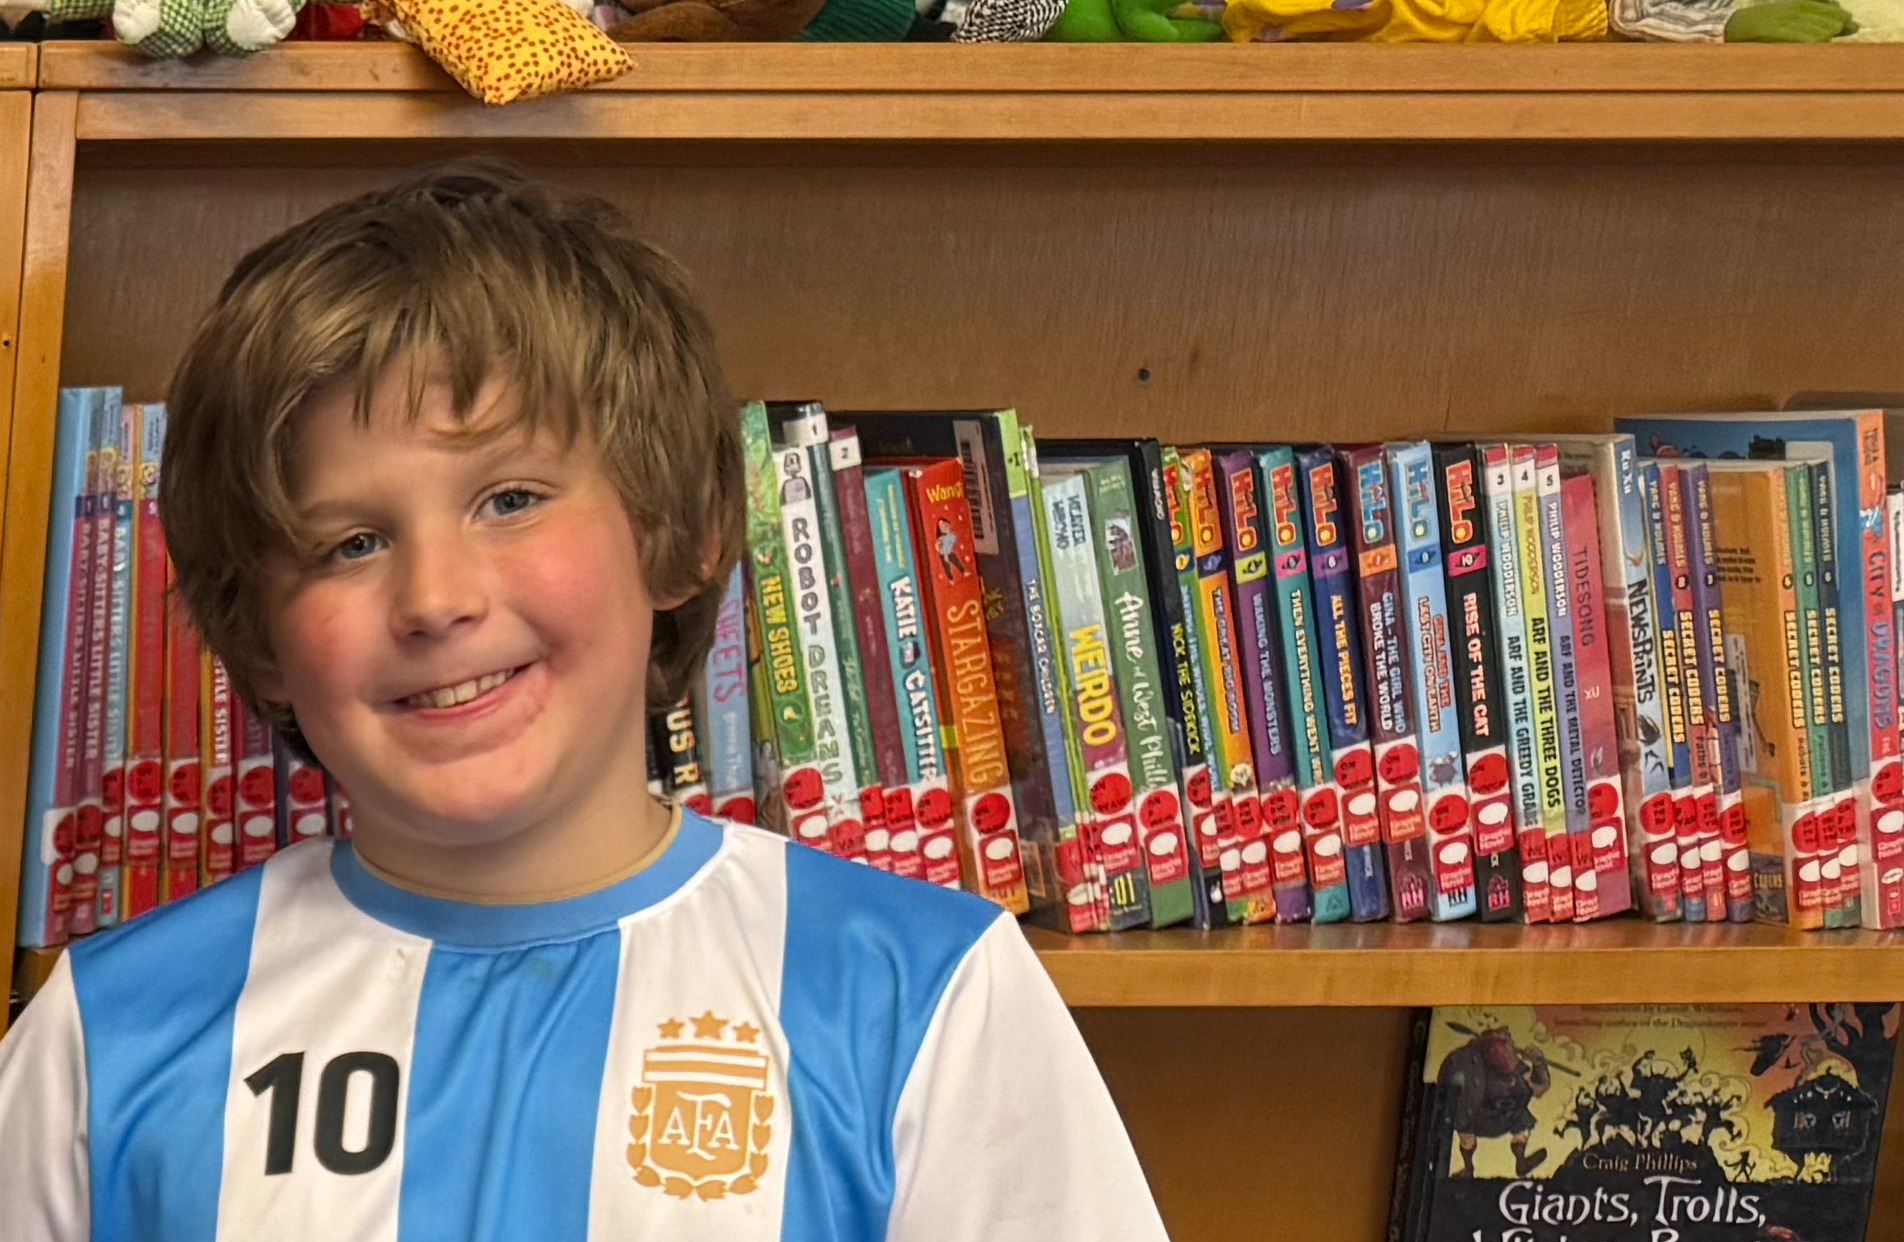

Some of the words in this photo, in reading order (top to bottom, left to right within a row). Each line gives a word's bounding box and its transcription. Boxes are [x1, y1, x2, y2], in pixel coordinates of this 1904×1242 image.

[761, 575, 787, 625] NEW
[1574, 549, 1596, 649] TIDESONG
[1867, 550, 1887, 599] CITY
[890, 575, 917, 640] KATIE
[1462, 591, 1478, 630] RISE
[1532, 616, 1547, 646] ARF
[1707, 608, 1725, 665] SECRET
[1824, 606, 1839, 665] SECRET
[767, 625, 798, 695] SHOES
[792, 517, 822, 636] ROBOT
[807, 643, 844, 786] DREAMS
[1170, 623, 1188, 659] NICK
[1369, 602, 1385, 641] BROKE
[1377, 675, 1394, 732] WORLD
[1464, 635, 1481, 664] OF
[1533, 644, 1550, 680] AND
[1679, 610, 1698, 667] SECRET
[1806, 608, 1821, 667] SECRET
[947, 599, 1004, 786] STARGAZING
[1069, 623, 1117, 746] WEIRDO
[1510, 665, 1526, 695] AND
[1685, 668, 1705, 727] CODERS
[1714, 665, 1732, 724] CODERS
[1810, 668, 1827, 727] CODERS
[1829, 665, 1845, 724] CODERS
[1474, 710, 1490, 739] CAT
[1514, 721, 1535, 780] GREEDY
[1538, 707, 1557, 757] THREE
[1543, 757, 1562, 810] DOGS
[243, 1050, 402, 1178] 10
[663, 1089, 740, 1159] AFA
[1582, 1153, 1629, 1172] Craig
[1634, 1153, 1699, 1173] Phillips
[1499, 1179, 1639, 1229] Giants,
[1644, 1176, 1767, 1228] Trolls,
